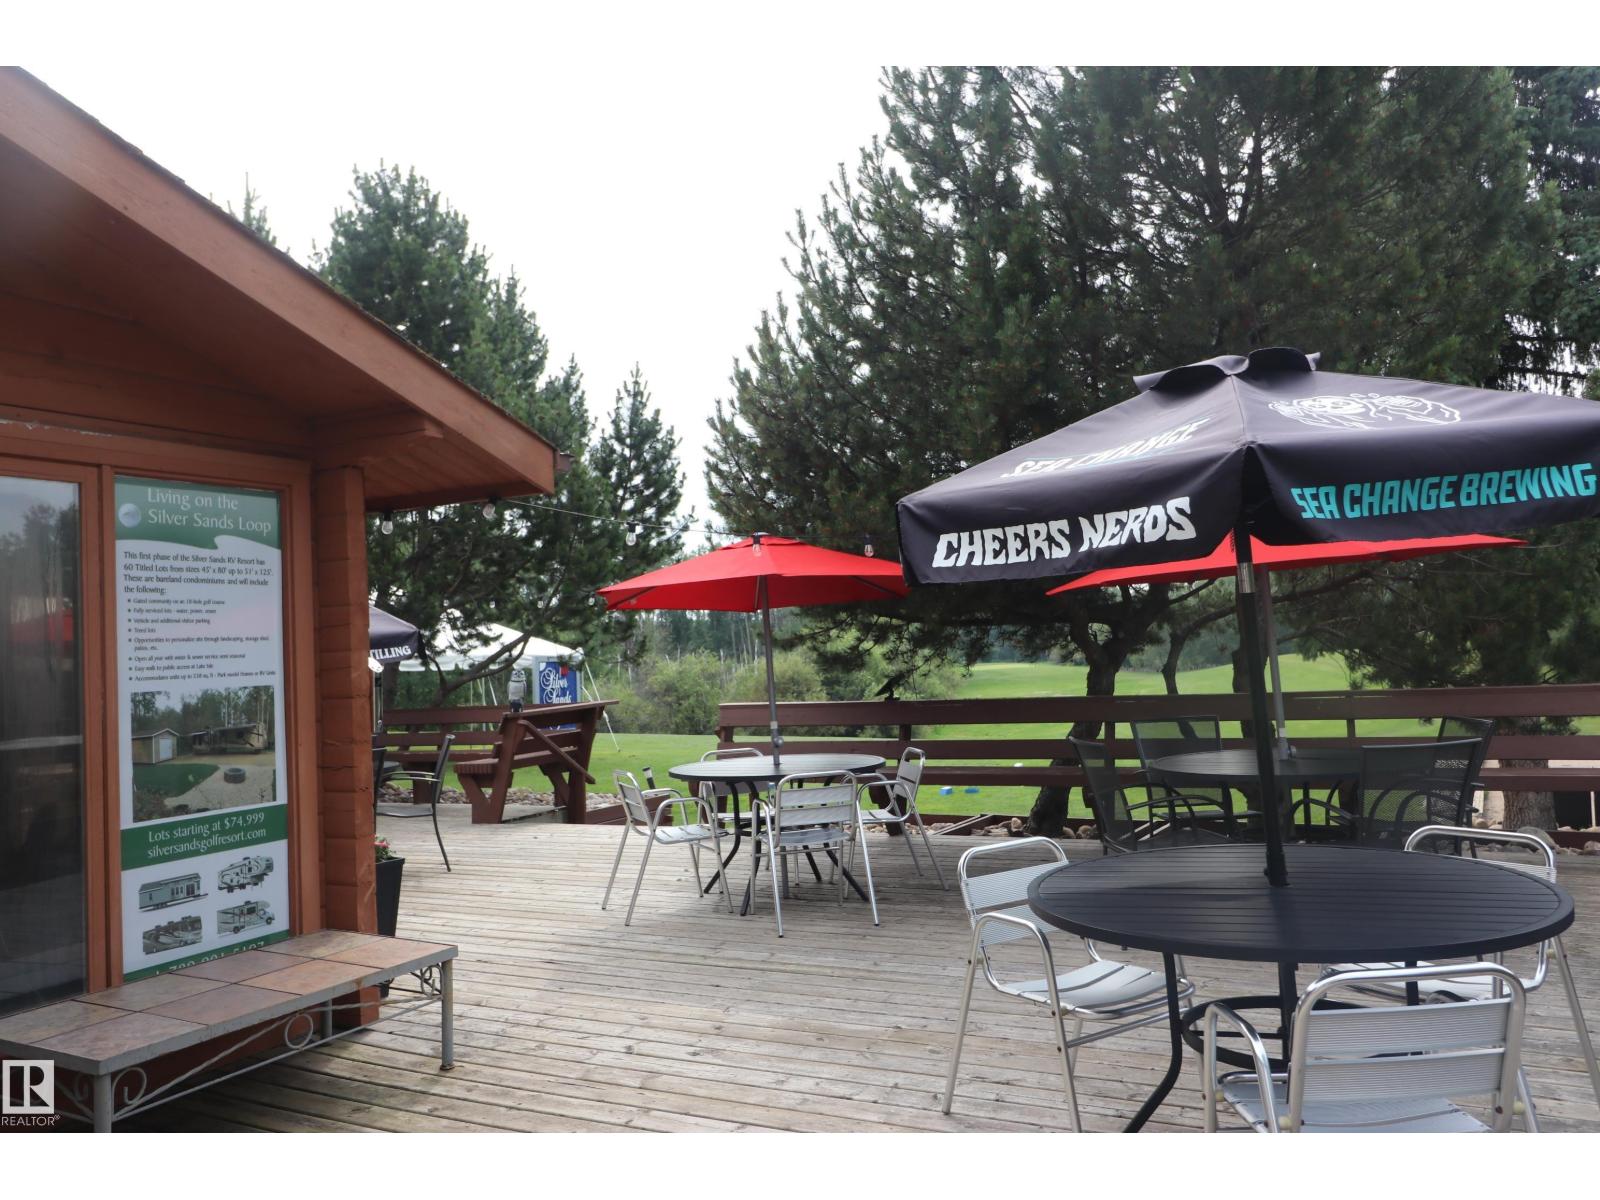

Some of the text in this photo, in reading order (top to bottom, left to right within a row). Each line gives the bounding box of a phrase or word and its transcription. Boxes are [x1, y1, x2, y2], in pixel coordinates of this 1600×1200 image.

[148, 487, 239, 511] Living on the
[1292, 463, 1598, 520] SEA CHANGE BREWING
[148, 508, 271, 536] Silver Sands Loop
[932, 497, 1197, 568] CHEERS NERDS
[123, 563, 134, 571] 60
[135, 563, 154, 572] Titled
[155, 564, 169, 572] Lots
[170, 565, 184, 573] from
[228, 568, 236, 576] up
[237, 567, 243, 575] to
[124, 551, 266, 566] This first phase of the Silver Sands RV Resort has
[124, 573, 143, 582] These
[144, 575, 155, 583] are
[183, 575, 226, 585] condominiums
[226, 577, 238, 585] and
[239, 577, 248, 586] will
[249, 577, 269, 586] include
[124, 584, 167, 596] the following:
[541, 667, 568, 690] Silver
[148, 811, 265, 843] Lots starting at $74,999
[148, 828, 267, 859] silversandsgolfresort.com
